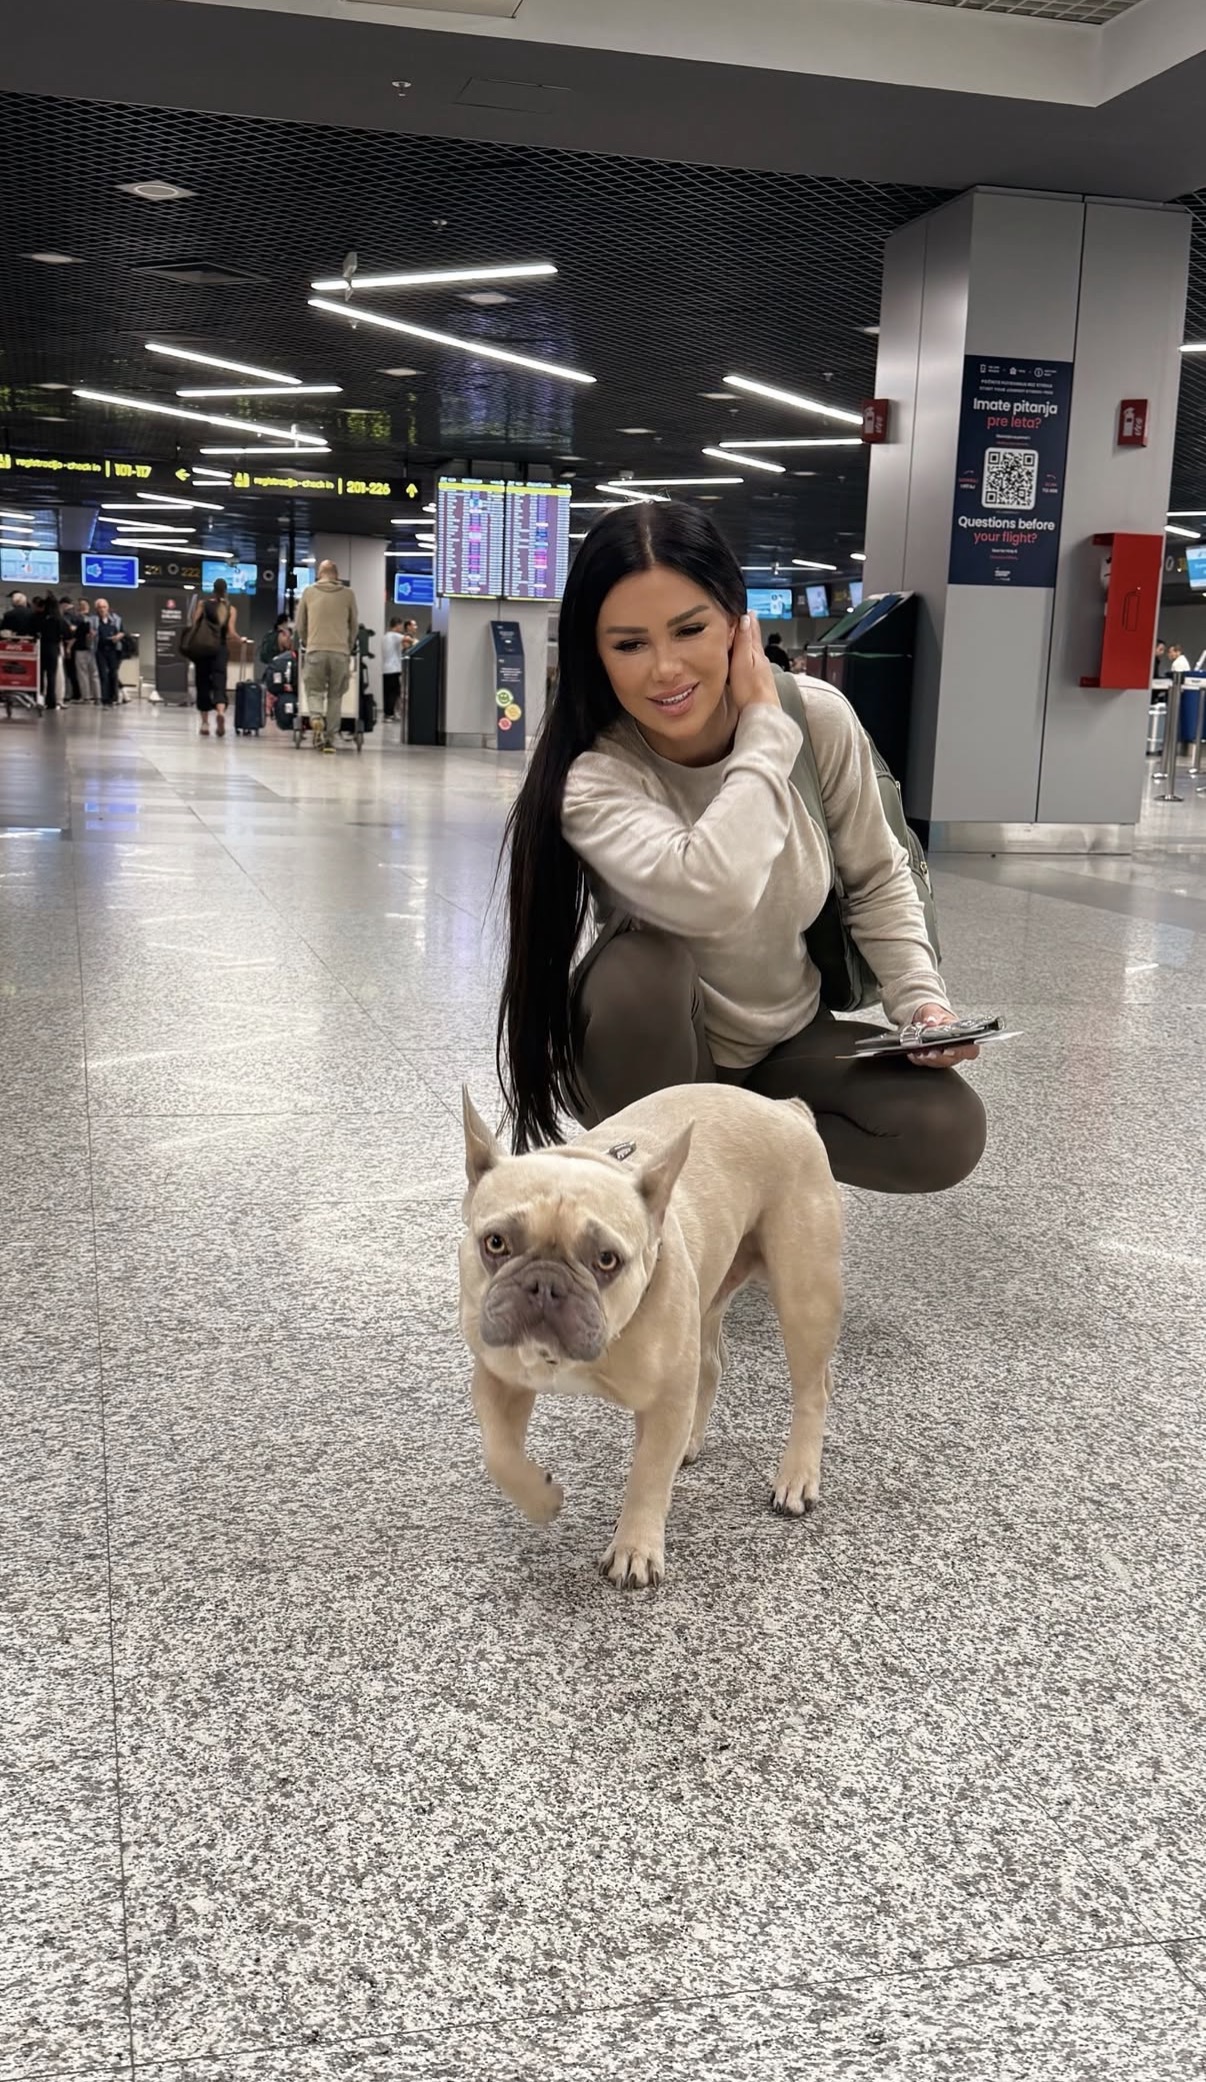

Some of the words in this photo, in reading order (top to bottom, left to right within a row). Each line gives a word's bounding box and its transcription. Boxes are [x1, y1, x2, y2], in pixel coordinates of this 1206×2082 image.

[973, 397, 1011, 411] Imate
[1013, 400, 1058, 418] pitanja
[987, 416, 1008, 429] pre
[1011, 416, 1042, 429] leta?
[114, 463, 152, 478] 101-117
[958, 515, 1016, 529] Questions
[1018, 518, 1055, 530] before
[973, 531, 1000, 545] your
[1002, 531, 1038, 546] flight?
